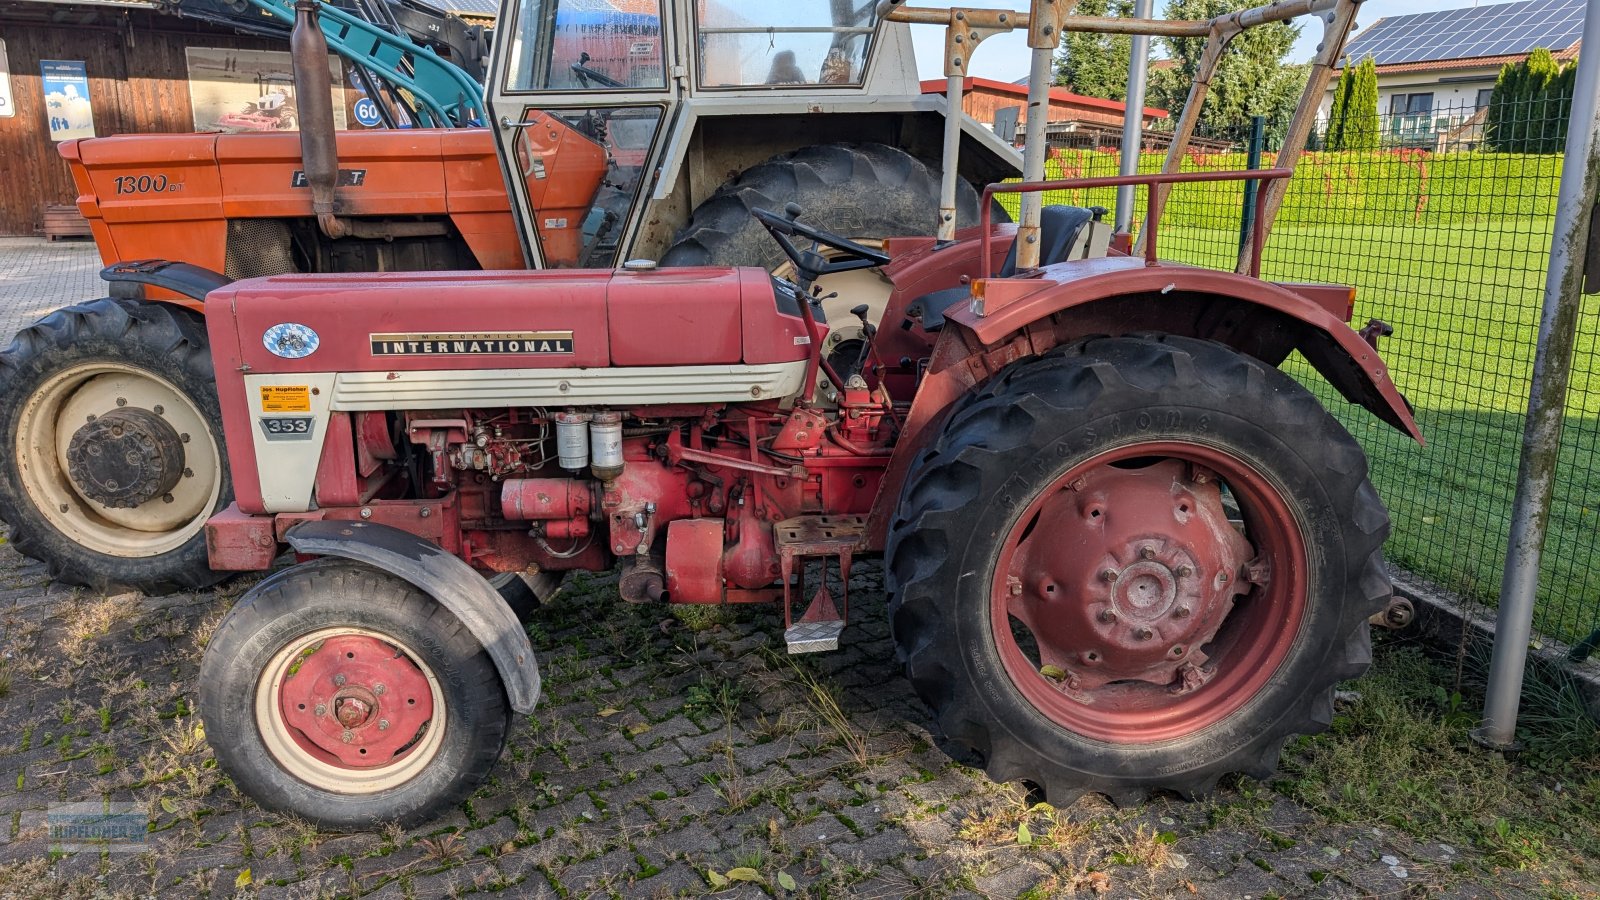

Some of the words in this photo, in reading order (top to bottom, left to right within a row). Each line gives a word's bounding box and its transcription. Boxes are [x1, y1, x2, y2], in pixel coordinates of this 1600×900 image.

[359, 104, 378, 119] 60
[114, 174, 168, 195] 1300
[296, 171, 362, 186] FT
[382, 340, 565, 354] INTERNATIONAL
[269, 420, 308, 432] 353
